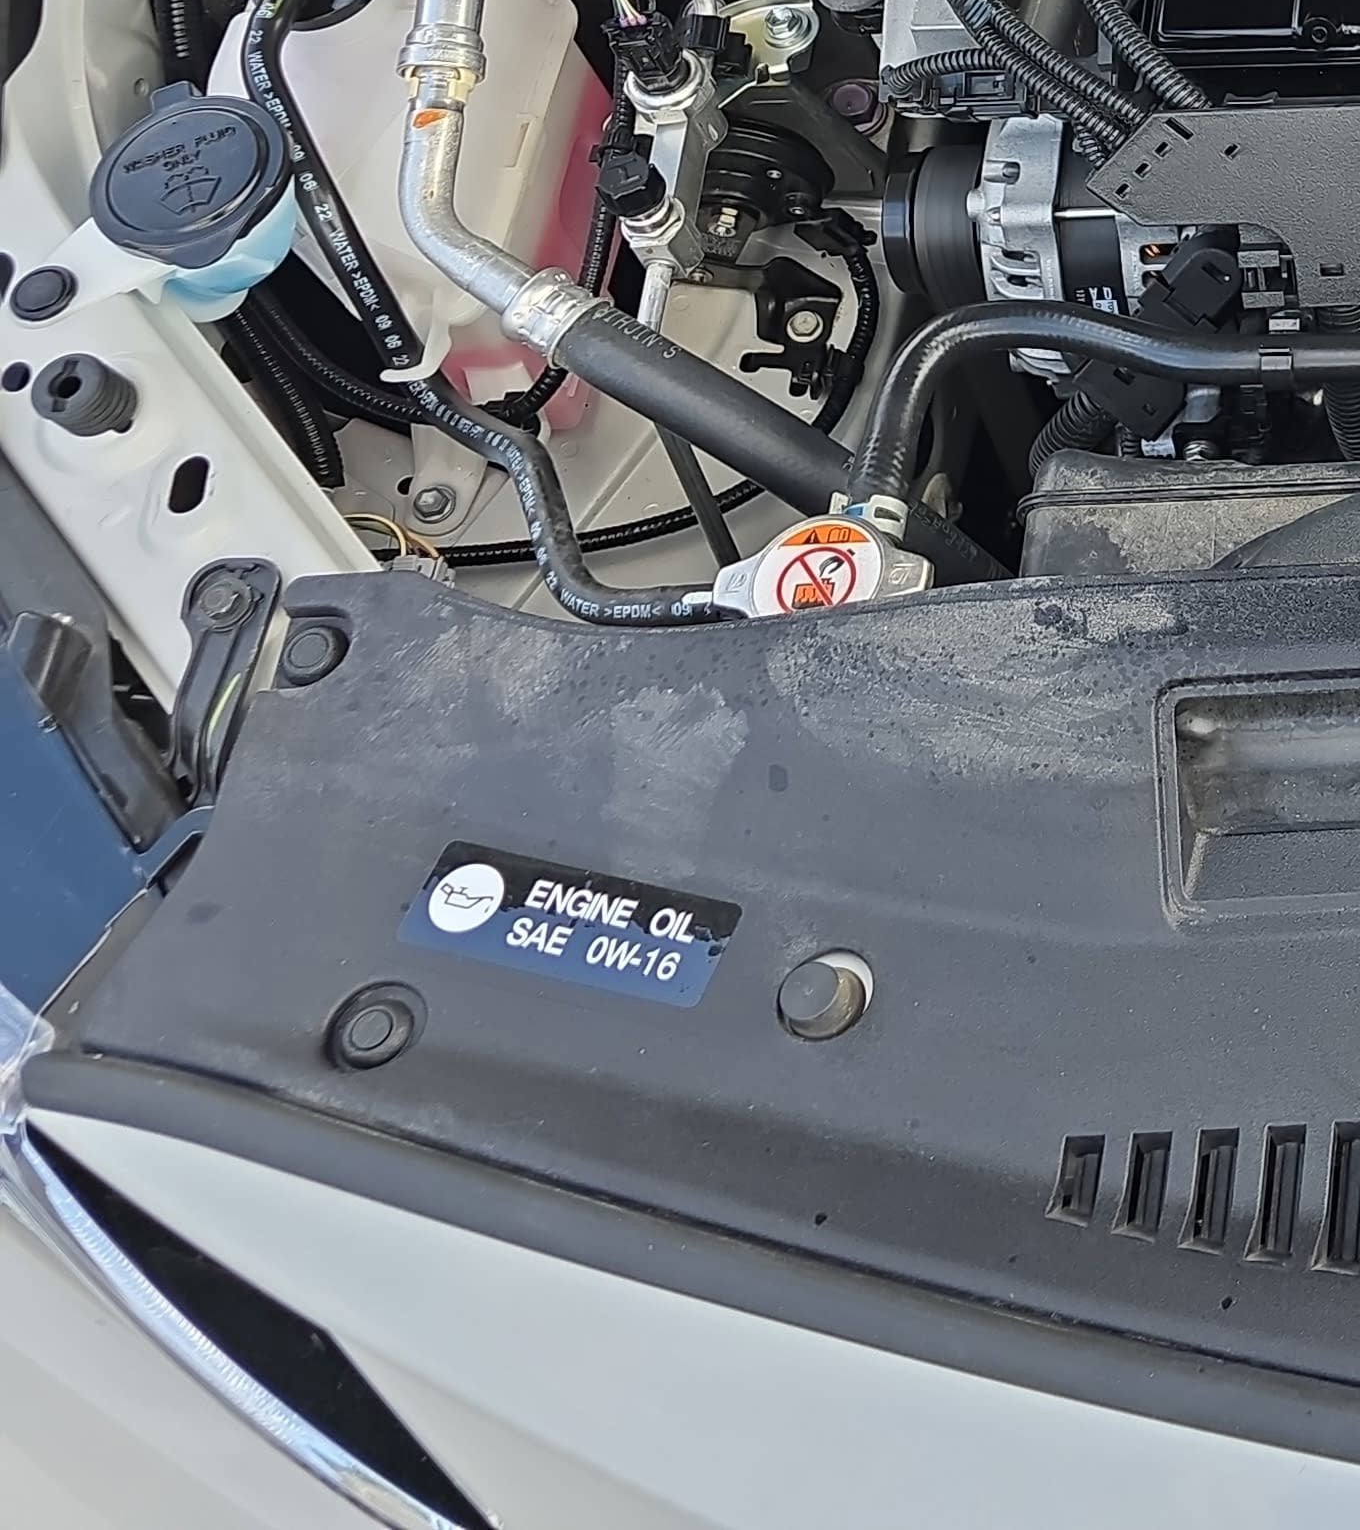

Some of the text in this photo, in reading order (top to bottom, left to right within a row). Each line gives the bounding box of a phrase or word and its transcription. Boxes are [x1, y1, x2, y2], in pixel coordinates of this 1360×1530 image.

[162, 150, 202, 172] ONLY
[248, 50, 272, 92] WATER
[314, 203, 333, 221] 22
[329, 230, 359, 272] WATER
[351, 271, 380, 312] >EPDM<
[516, 473, 537, 517] >EPDM<
[545, 570, 558, 590] 22
[559, 588, 601, 618] WATER
[604, 603, 661, 619] >EPDM<
[523, 879, 696, 944] ENGINE OIL
[505, 916, 682, 982] SAE 0W-16
